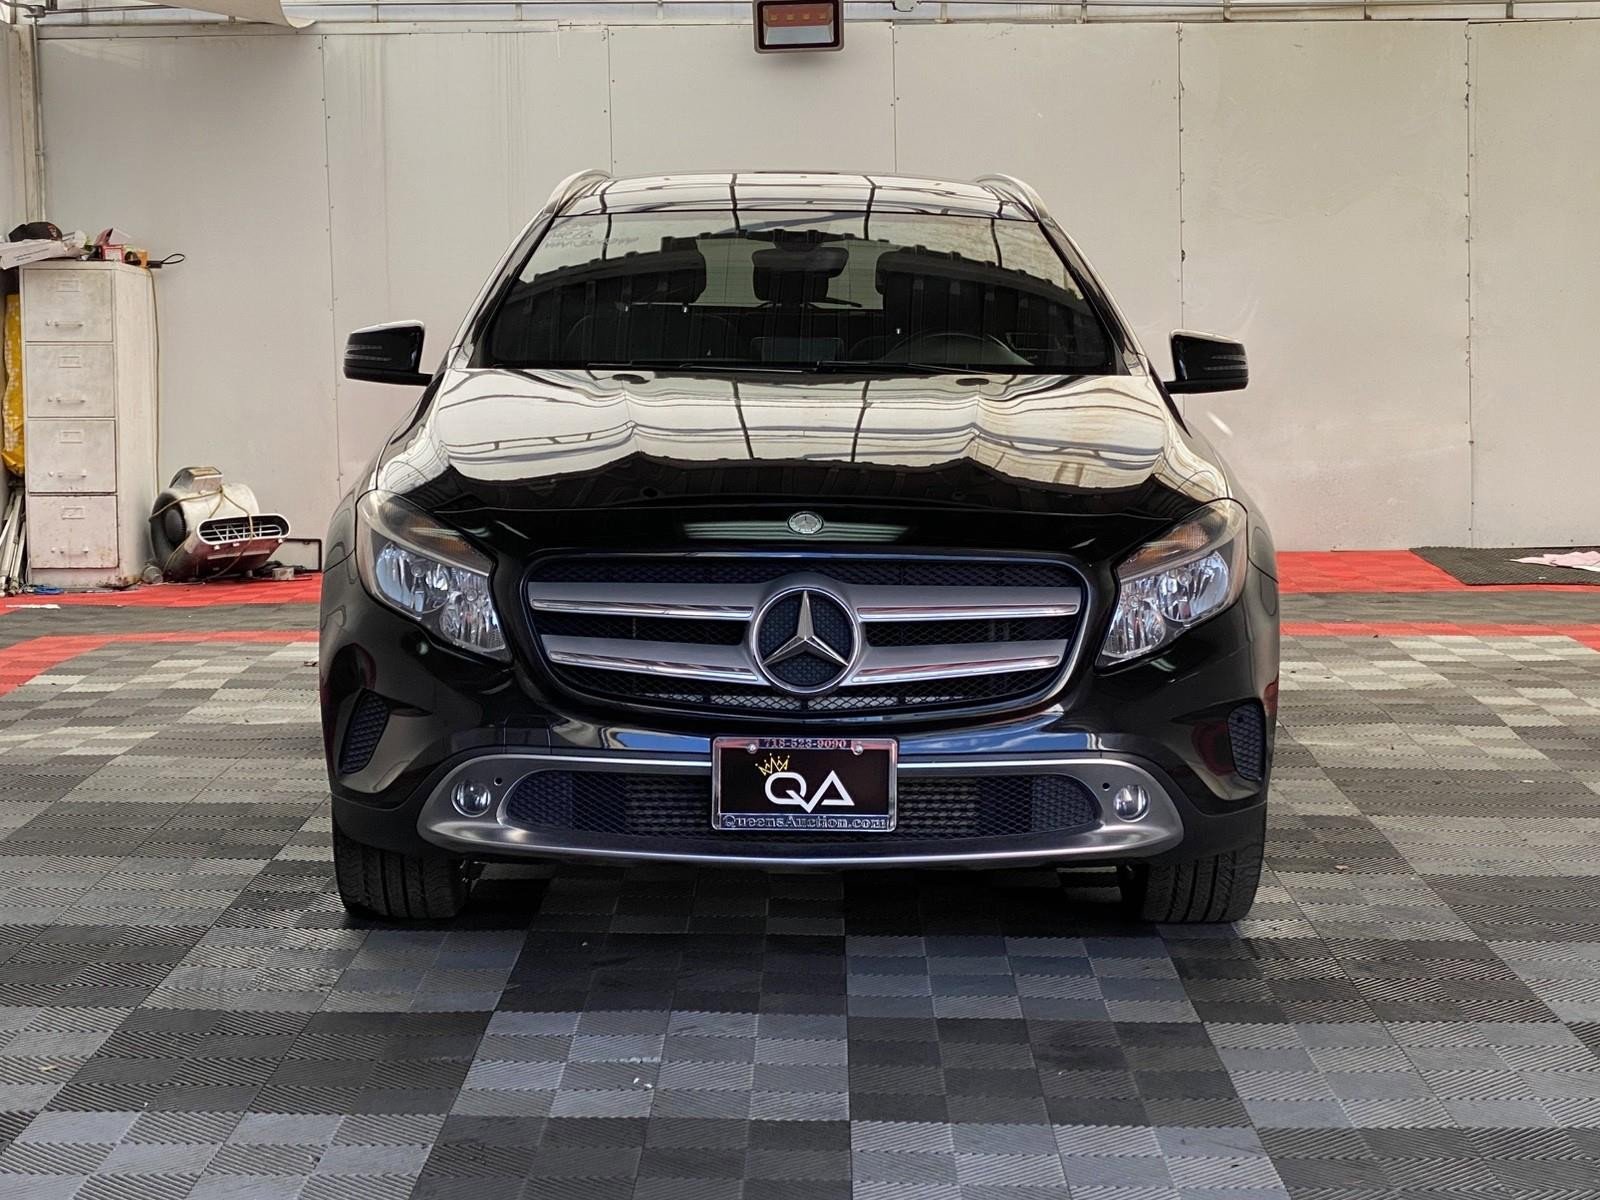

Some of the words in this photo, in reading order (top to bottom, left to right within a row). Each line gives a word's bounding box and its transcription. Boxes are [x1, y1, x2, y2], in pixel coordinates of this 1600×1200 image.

[764, 738, 847, 749] 718-523-9090
[764, 770, 855, 813] QA
[722, 814, 886, 829] QueensAuction.com
